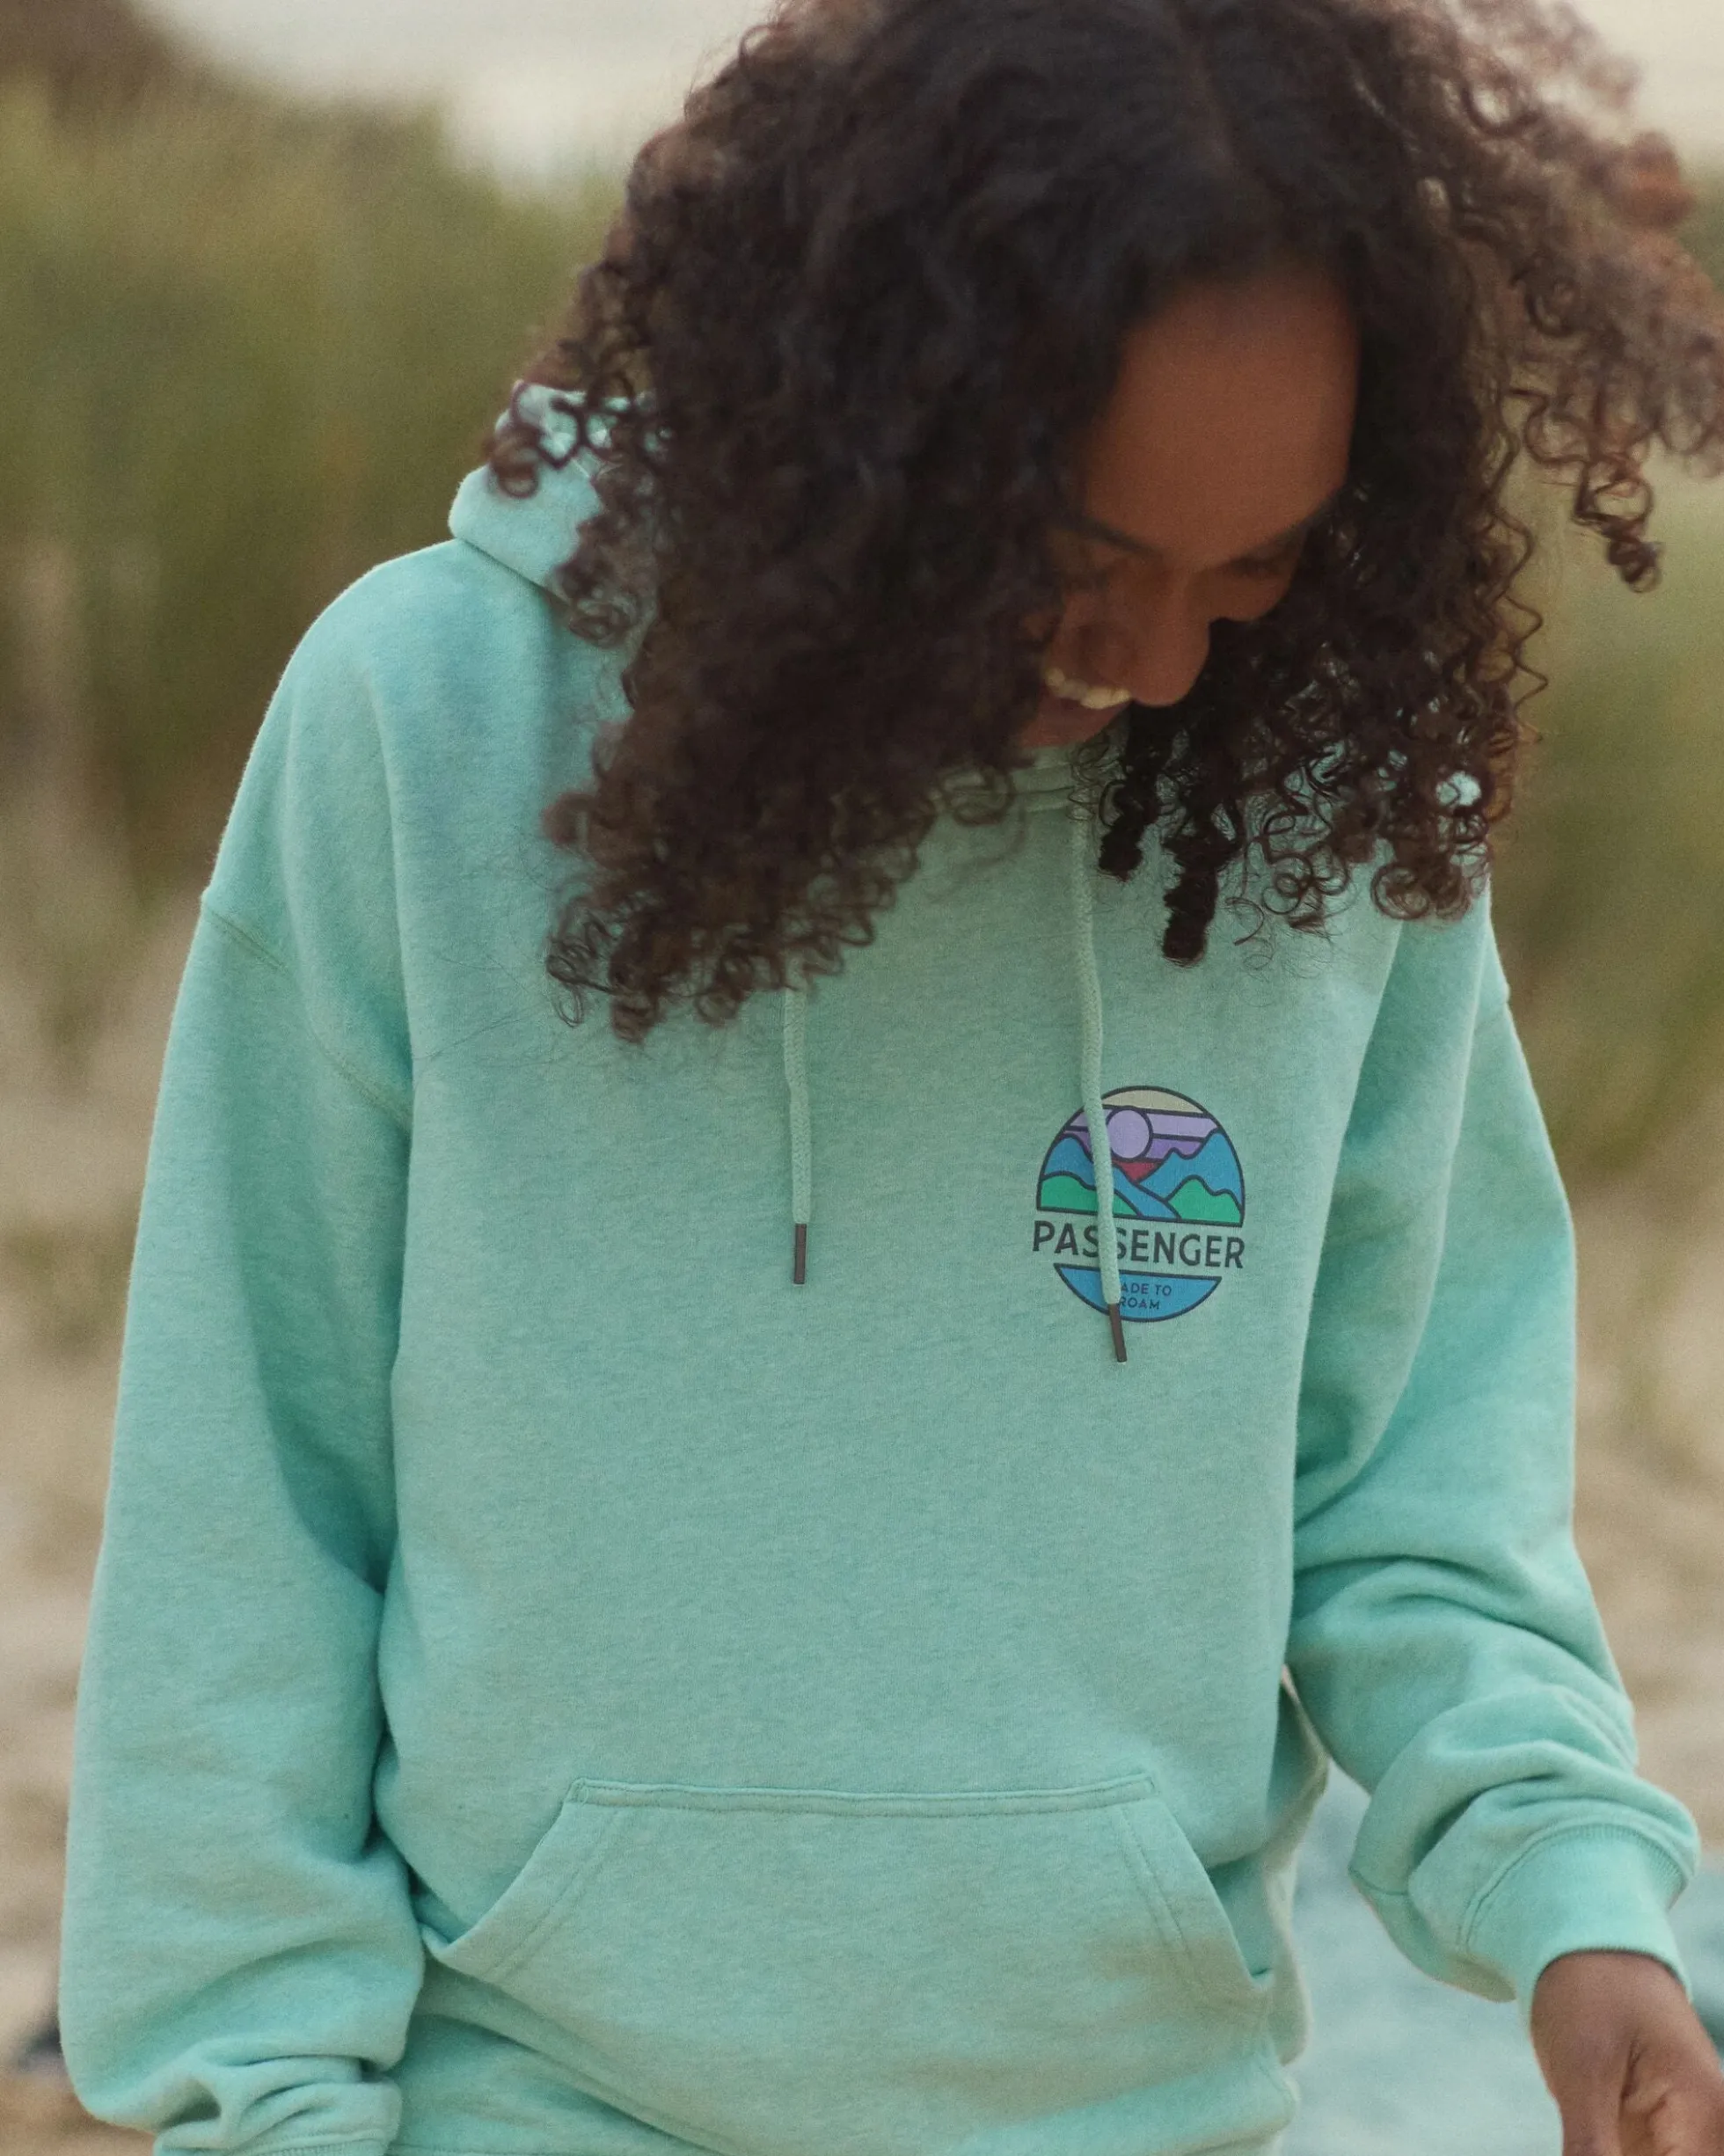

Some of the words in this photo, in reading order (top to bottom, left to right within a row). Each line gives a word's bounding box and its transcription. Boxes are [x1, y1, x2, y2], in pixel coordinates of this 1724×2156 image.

[1033, 1220, 1246, 1268] PASSENGER
[1121, 1283, 1150, 1294] ADE
[1155, 1284, 1172, 1297] TO
[1119, 1297, 1160, 1310] ROAM
